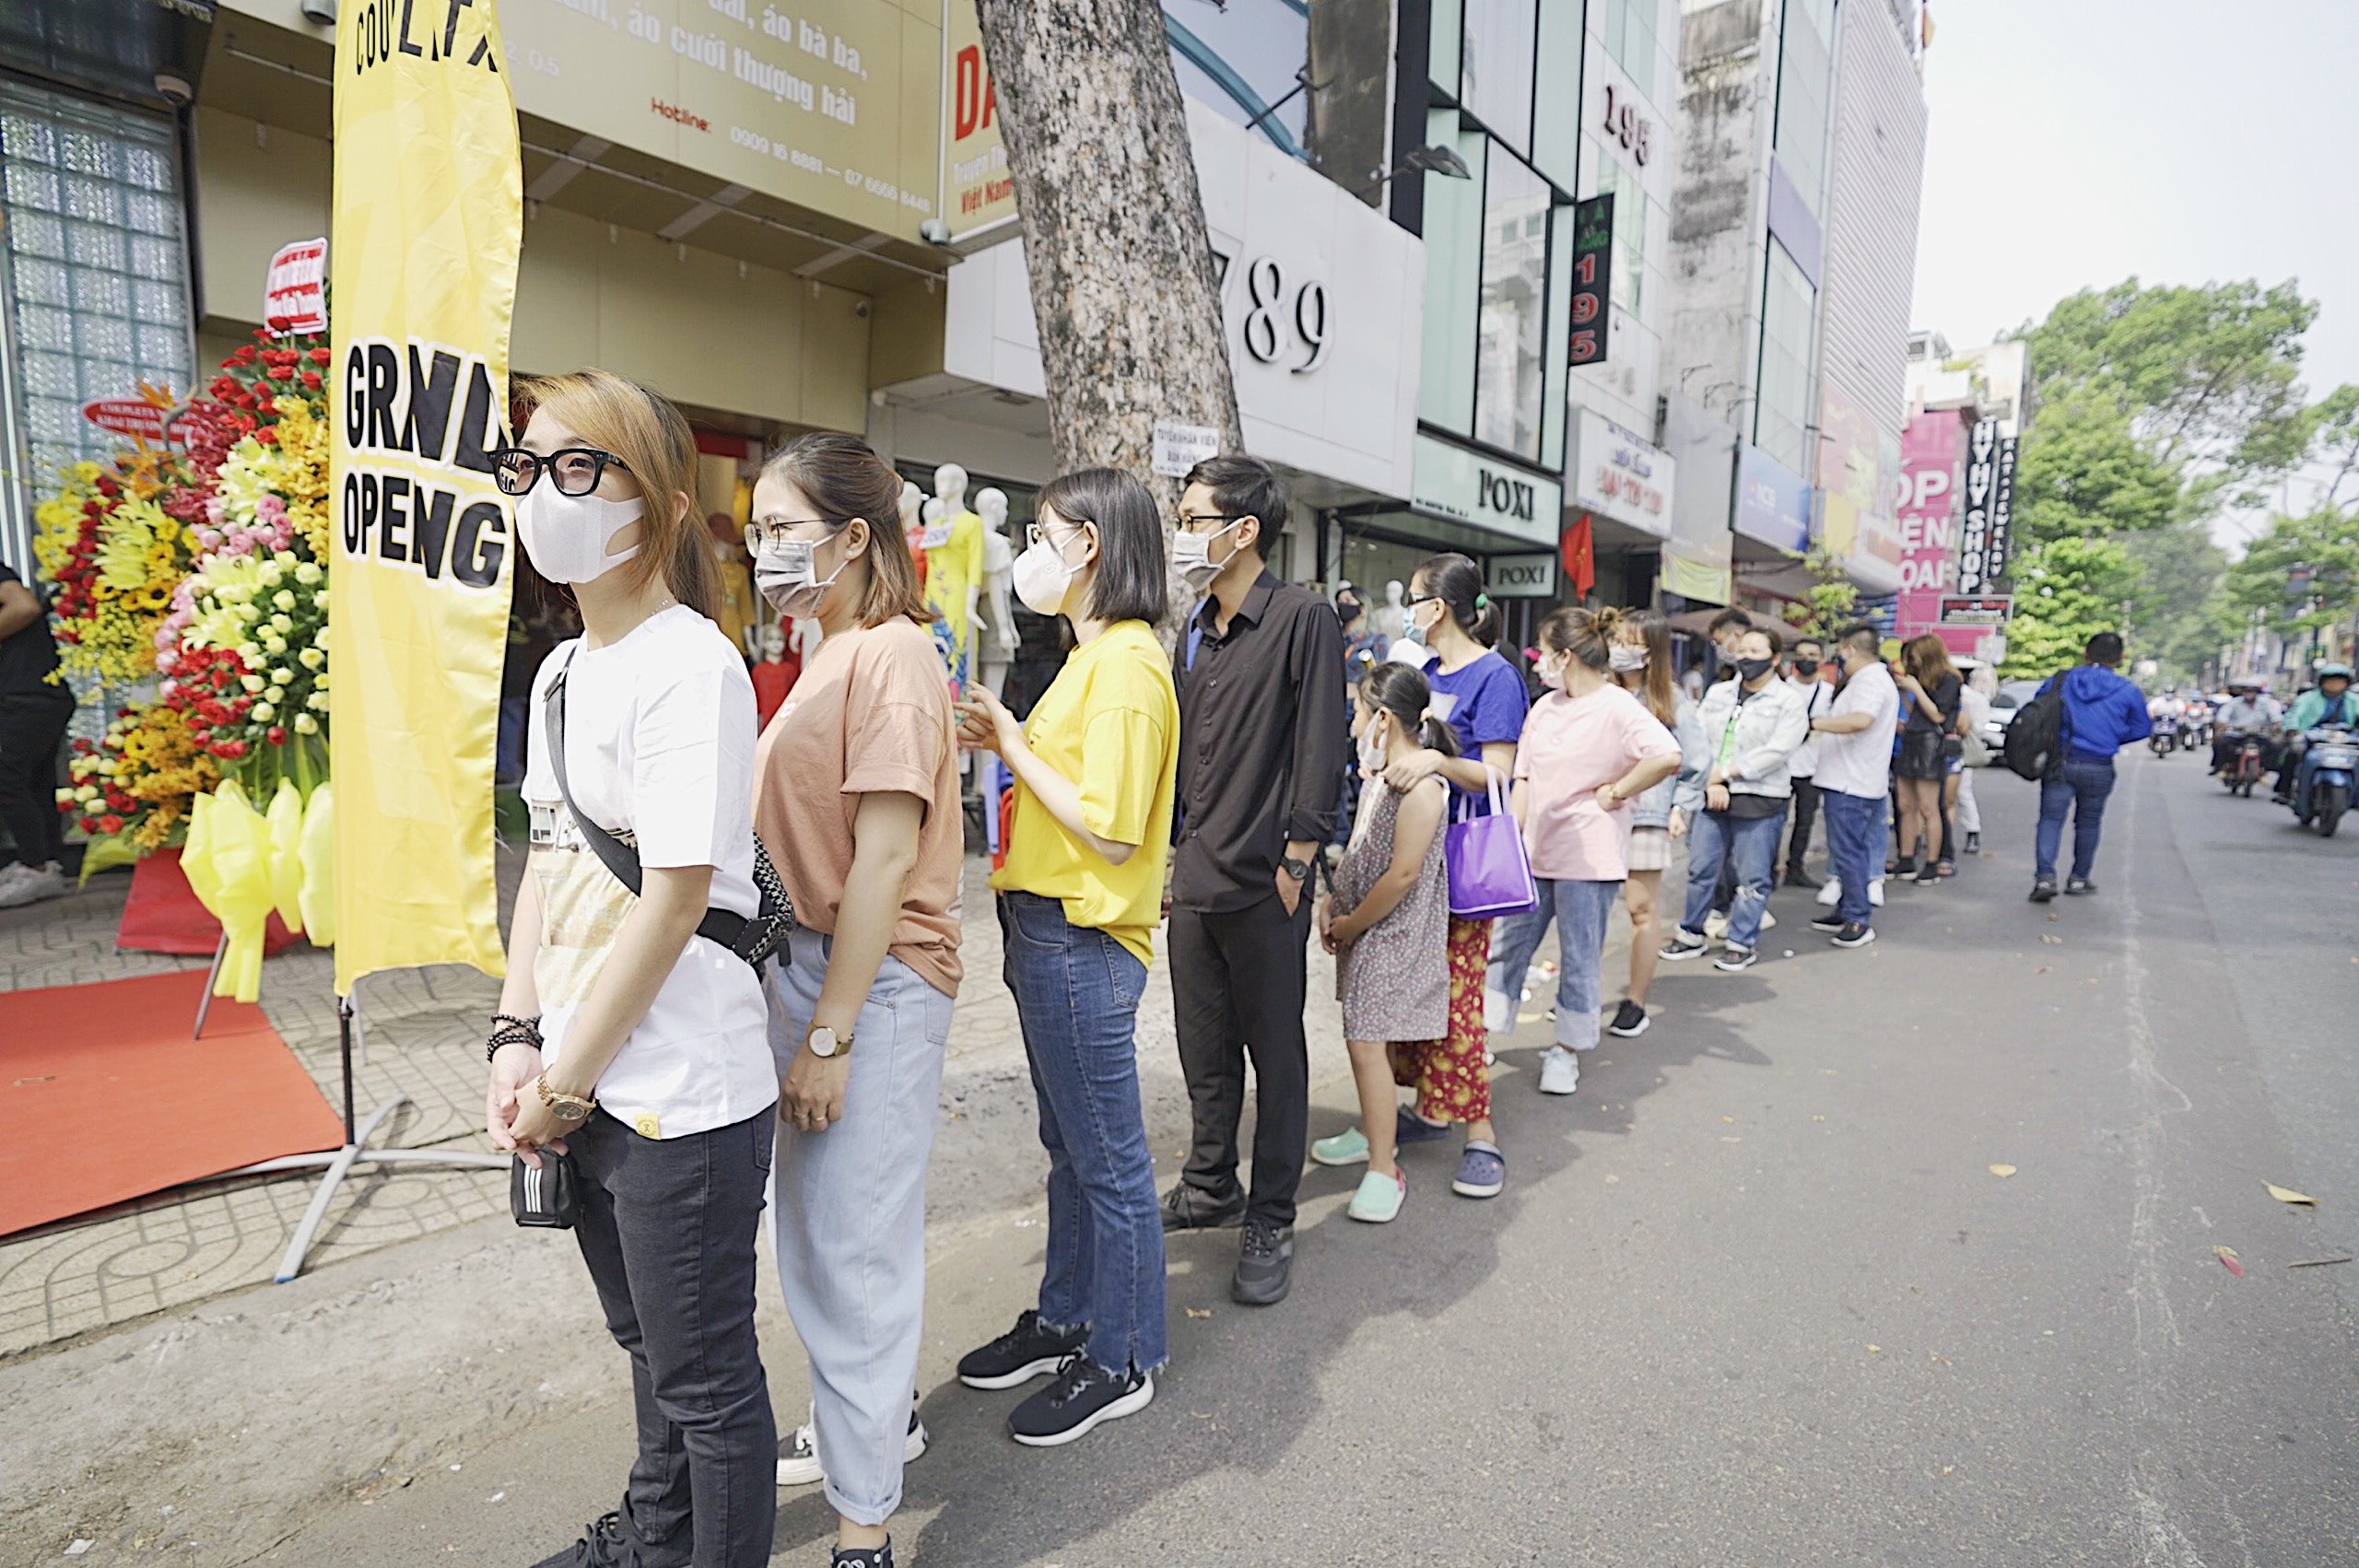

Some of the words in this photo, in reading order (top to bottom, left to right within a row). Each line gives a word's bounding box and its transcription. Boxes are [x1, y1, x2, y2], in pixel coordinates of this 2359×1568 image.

[628, 3, 661, 44] áo
[672, 26, 726, 72] cưới
[762, 4, 792, 42] áo
[799, 18, 827, 59] bà
[833, 35, 867, 80] ba,
[651, 96, 712, 134] Hotline:
[731, 126, 769, 154] 0909
[1570, 252, 1600, 361] 195
[1478, 468, 1534, 522] POXI
[1967, 420, 1995, 507] HYHY
[1497, 565, 1546, 586] POXI
[1960, 509, 1986, 594] SHOP
